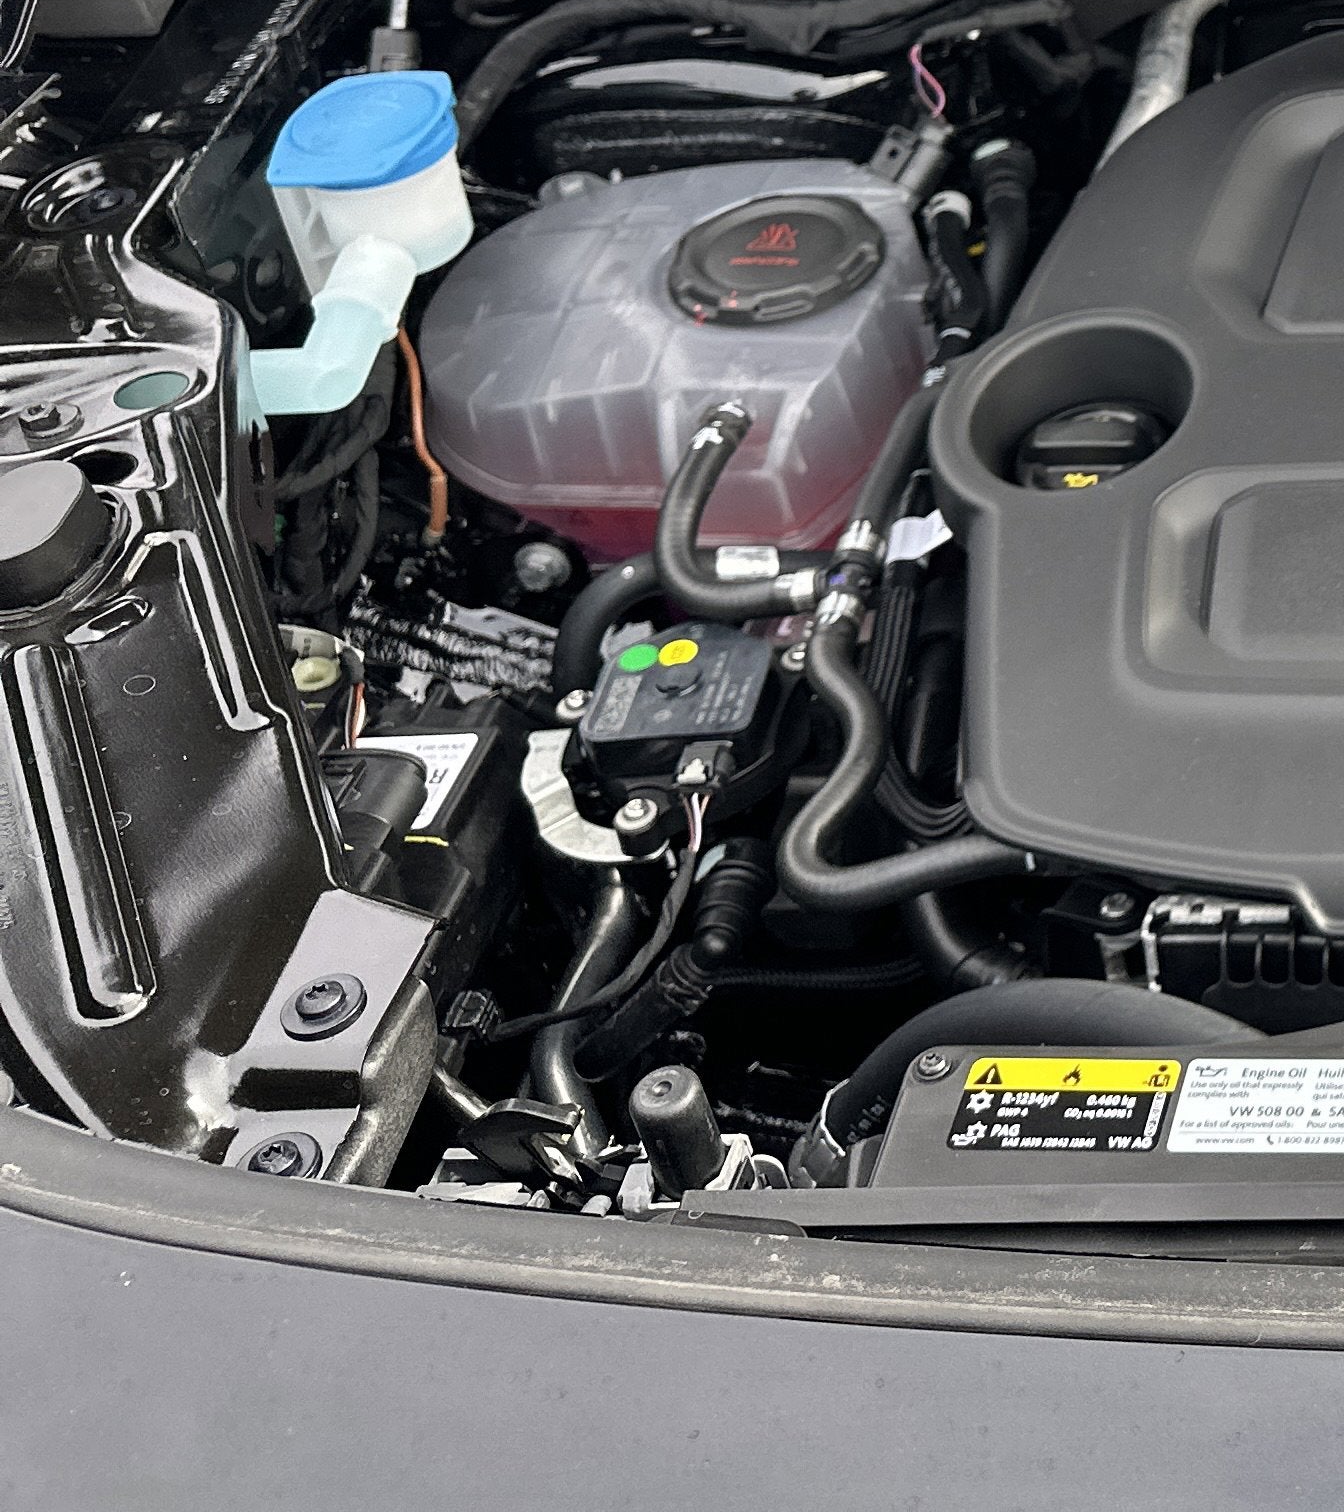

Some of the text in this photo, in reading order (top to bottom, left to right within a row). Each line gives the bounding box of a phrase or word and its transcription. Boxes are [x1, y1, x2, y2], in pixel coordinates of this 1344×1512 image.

[1241, 1067, 1307, 1080] Engine Oil
[1262, 1081, 1304, 1090] expressly
[1121, 1094, 1137, 1109] kg
[1230, 1106, 1255, 1117] VW
[1256, 1106, 1282, 1117] 508
[1285, 1106, 1304, 1117] 00
[990, 1124, 1021, 1138] PAG
[1108, 1136, 1132, 1148] VW
[1131, 1136, 1153, 1149] AG
